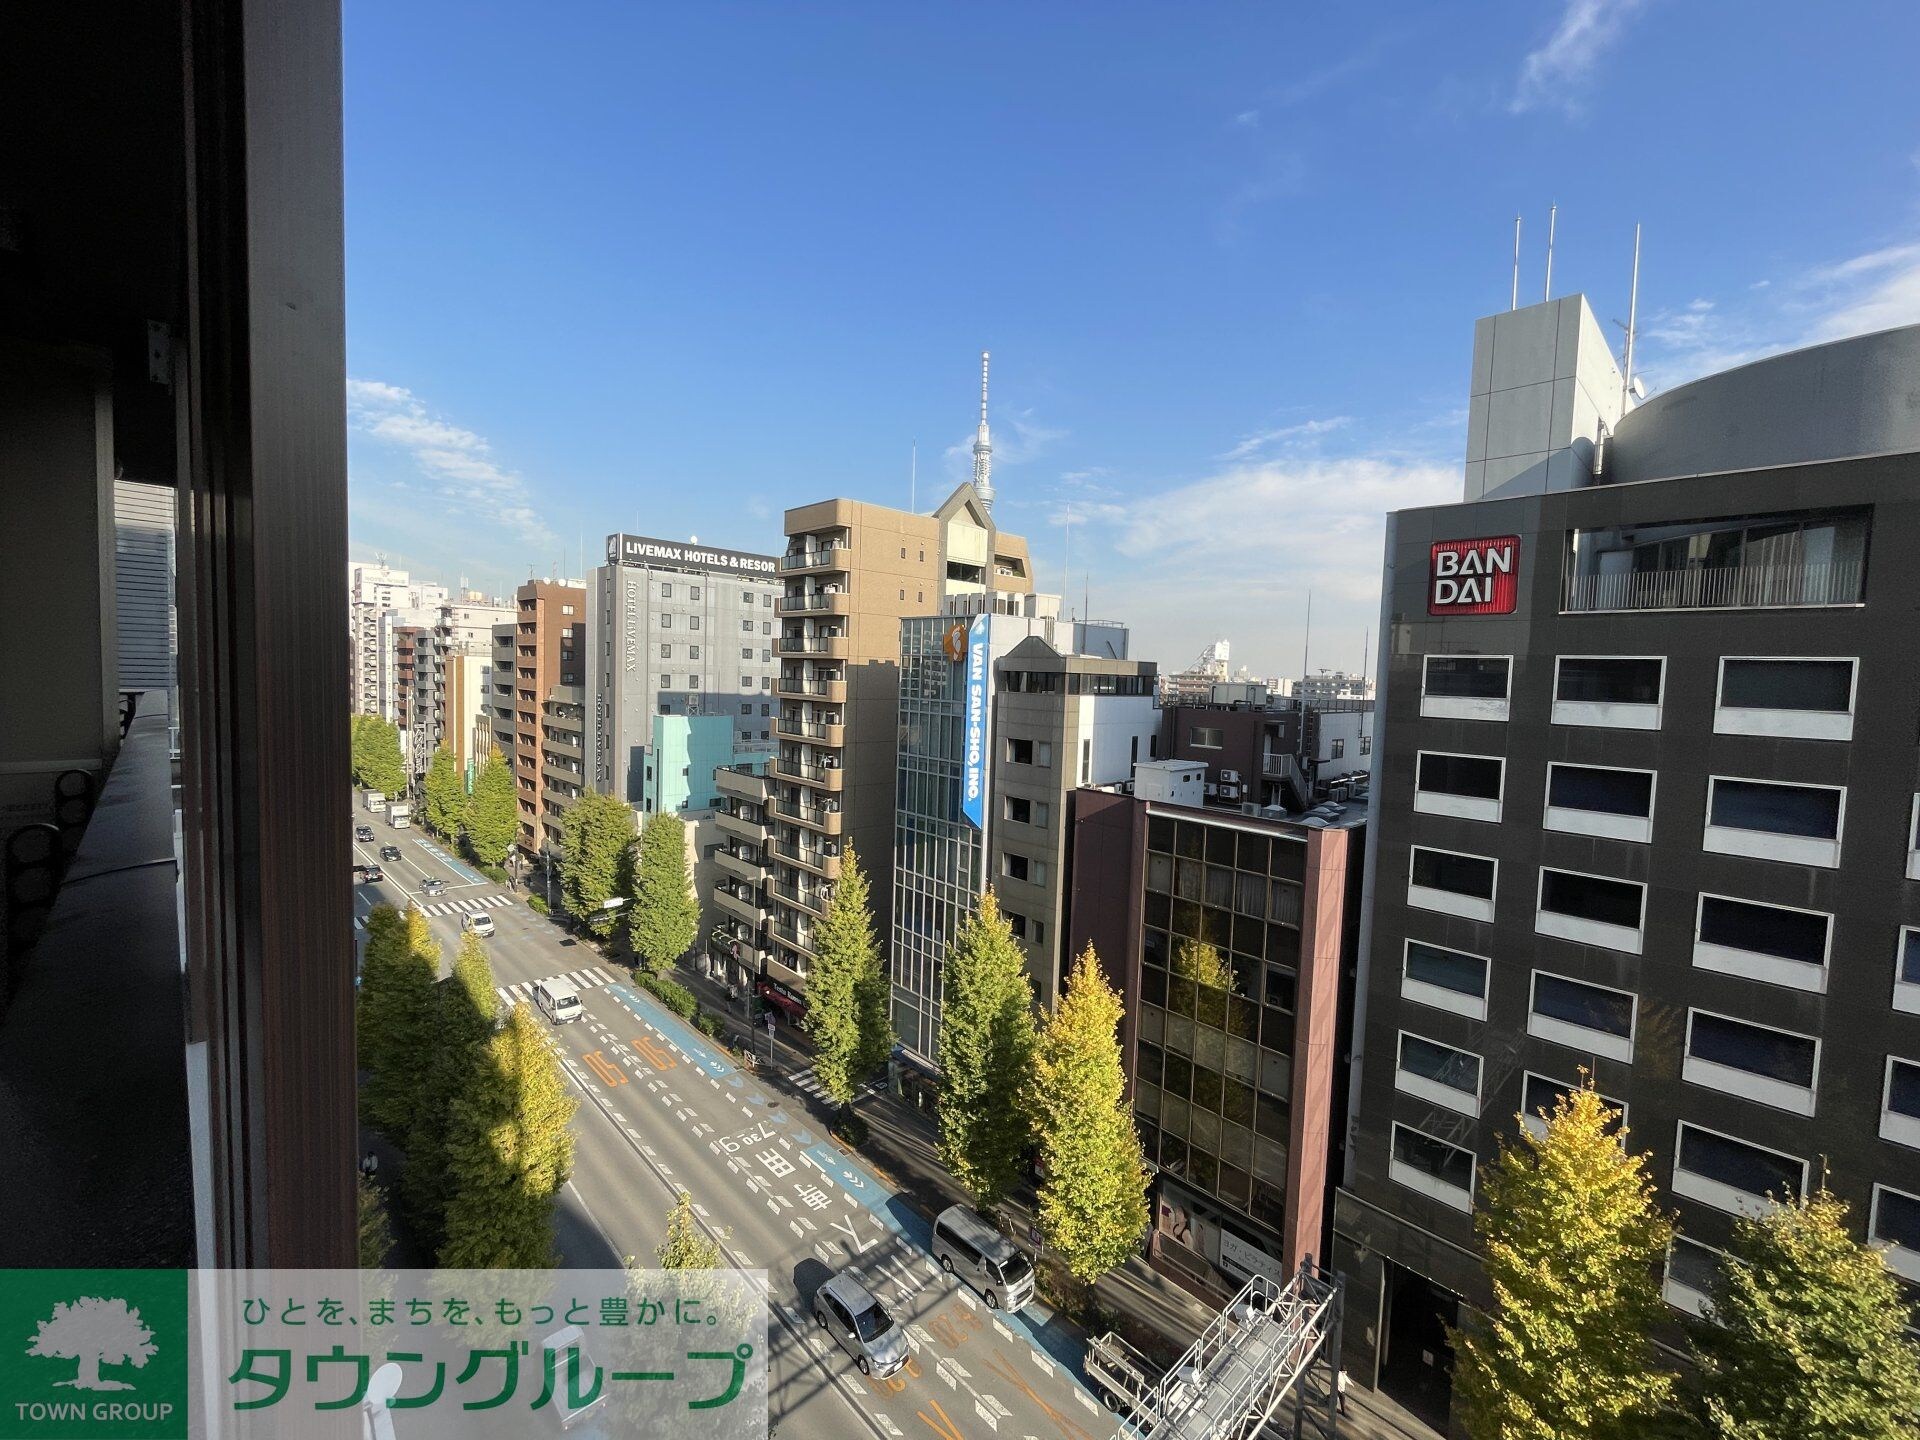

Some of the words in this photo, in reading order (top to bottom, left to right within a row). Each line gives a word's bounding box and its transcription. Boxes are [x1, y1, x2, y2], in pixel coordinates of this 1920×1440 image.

[626, 541, 682, 561] LIVEMAX
[684, 550, 728, 567] HOTELS
[729, 557, 739, 567] &
[1436, 546, 1510, 574] BAN
[625, 580, 639, 618] HOTEL
[1434, 577, 1492, 604] DAI
[972, 643, 983, 680] VAN
